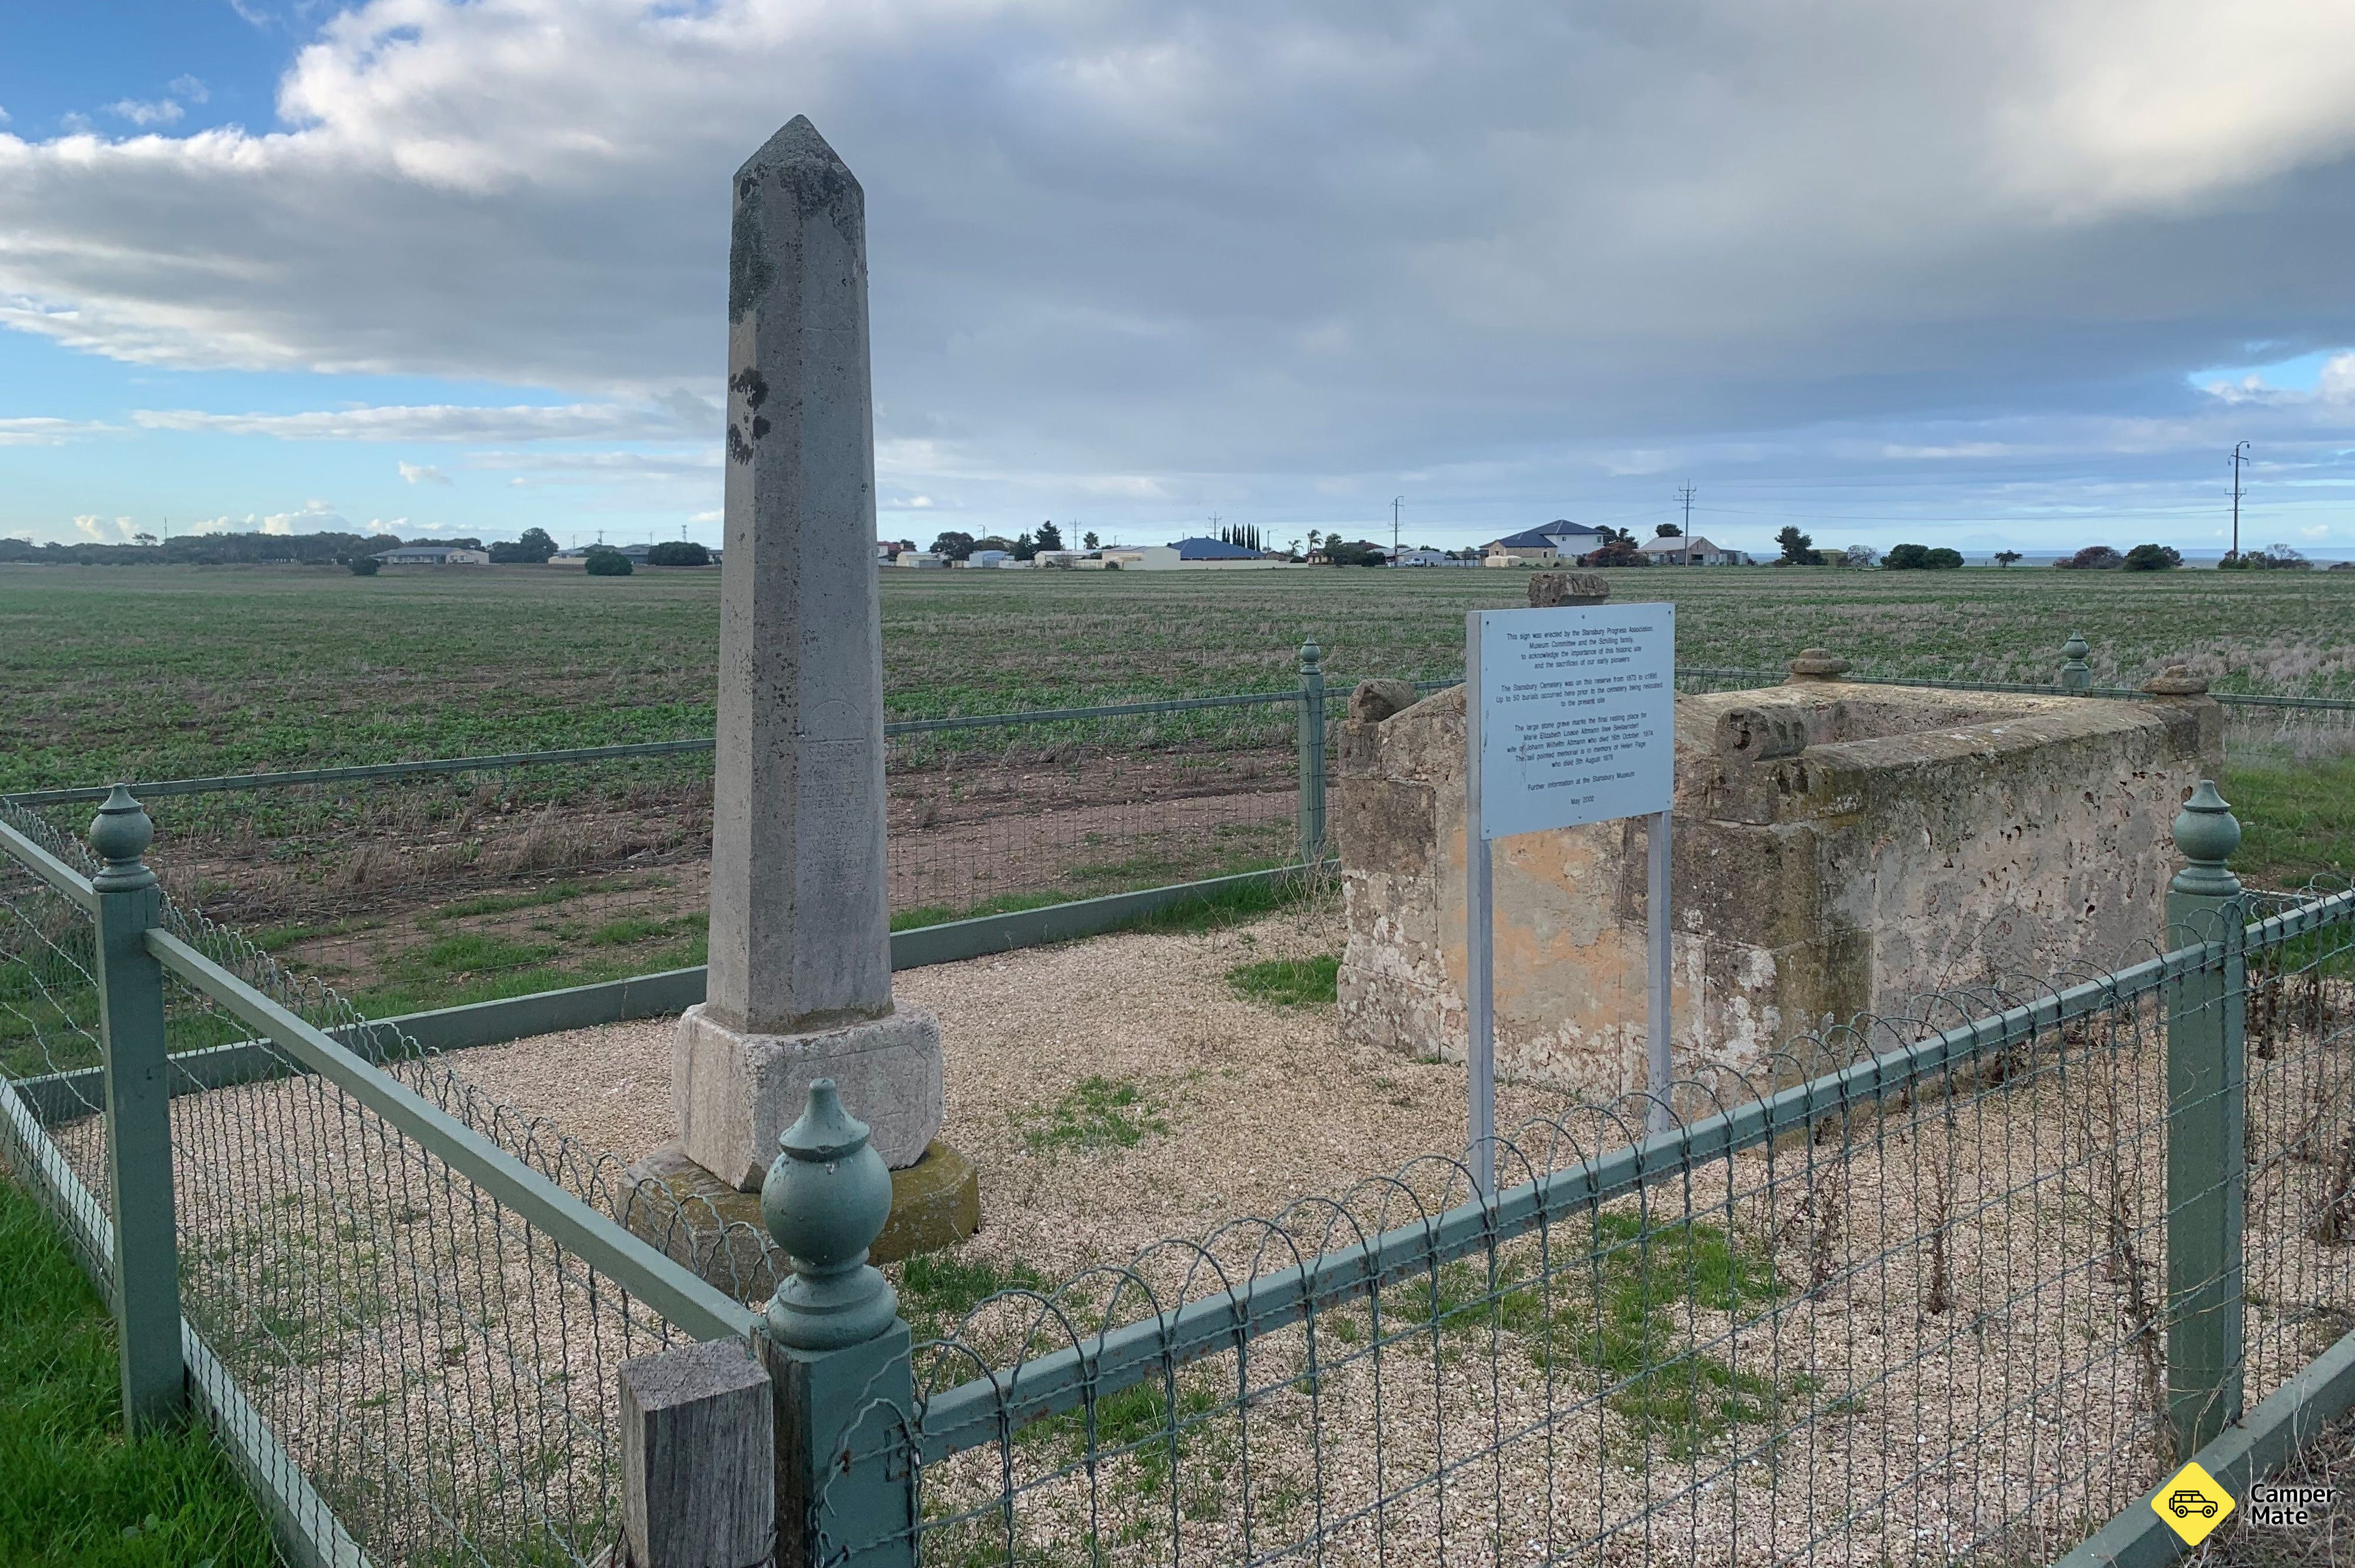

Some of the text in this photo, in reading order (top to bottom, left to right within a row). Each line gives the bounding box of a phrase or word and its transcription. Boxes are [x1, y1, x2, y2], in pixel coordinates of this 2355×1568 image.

[1581, 628, 1604, 636] Stansbury
[1607, 627, 1627, 636] Progress
[1528, 652, 1559, 660] acknowledge
[1571, 649, 1597, 657] importance
[1597, 657, 1609, 665] early
[1513, 683, 1537, 692] Stansbury
[1522, 693, 1539, 701] burials
[1541, 691, 1563, 699] occurred
[1577, 698, 1596, 706] present
[1556, 720, 1570, 729] grave
[1540, 731, 1561, 740] Elizabeth
[1537, 752, 1555, 761] pointed
[1585, 756, 1601, 765] August
[1547, 779, 1574, 788] information
[1592, 774, 1614, 783] Stansbury
